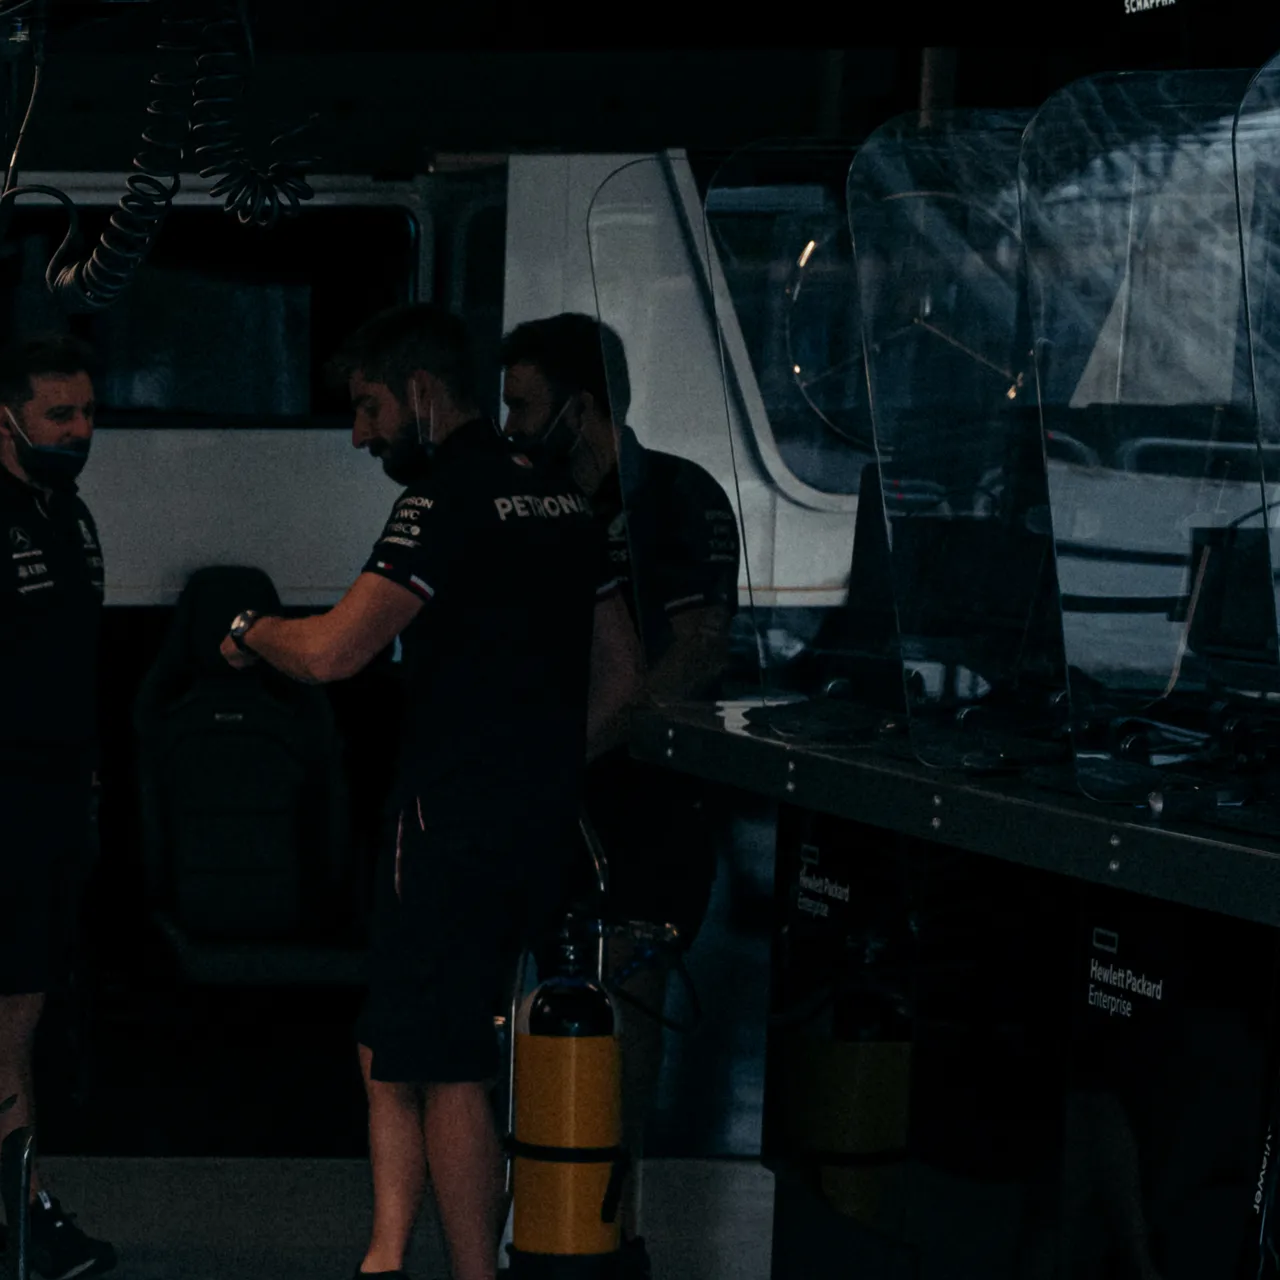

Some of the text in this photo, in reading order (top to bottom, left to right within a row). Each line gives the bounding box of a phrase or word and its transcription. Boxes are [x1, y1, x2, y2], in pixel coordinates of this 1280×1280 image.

[1090, 957, 1163, 1001] Hewlett Packard
[1088, 983, 1132, 1018] Enterprise
